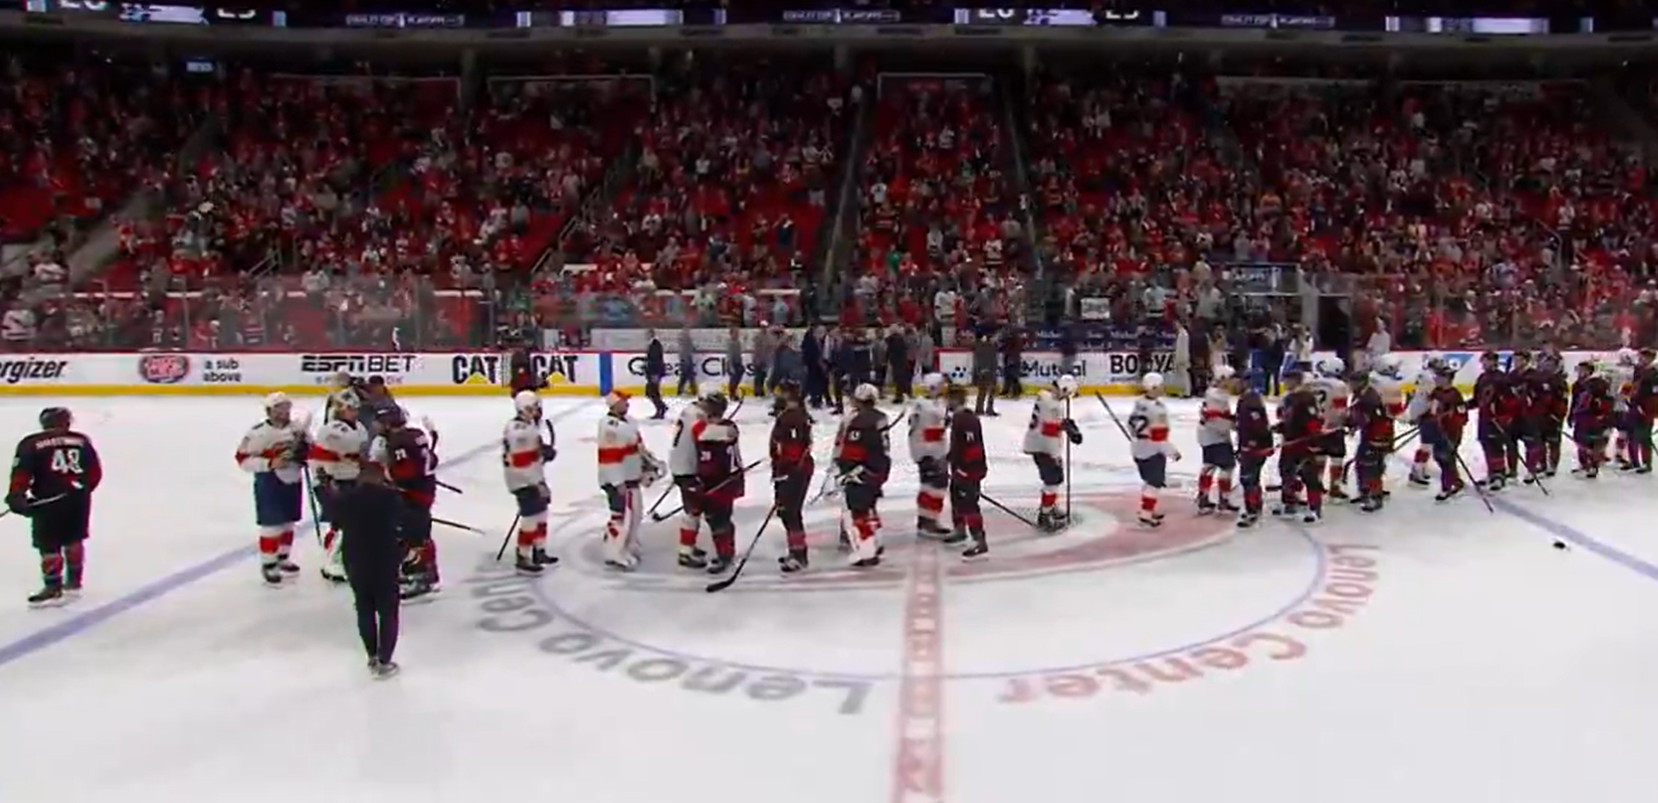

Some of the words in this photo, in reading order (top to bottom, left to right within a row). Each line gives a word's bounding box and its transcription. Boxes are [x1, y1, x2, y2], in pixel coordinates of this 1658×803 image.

[452, 355, 499, 384] CAT
[533, 355, 578, 384] CAT
[51, 449, 83, 473] 48
[1287, 544, 1380, 630] Lenovo
[540, 632, 875, 715] Lenovo
[998, 631, 1308, 704] Center
